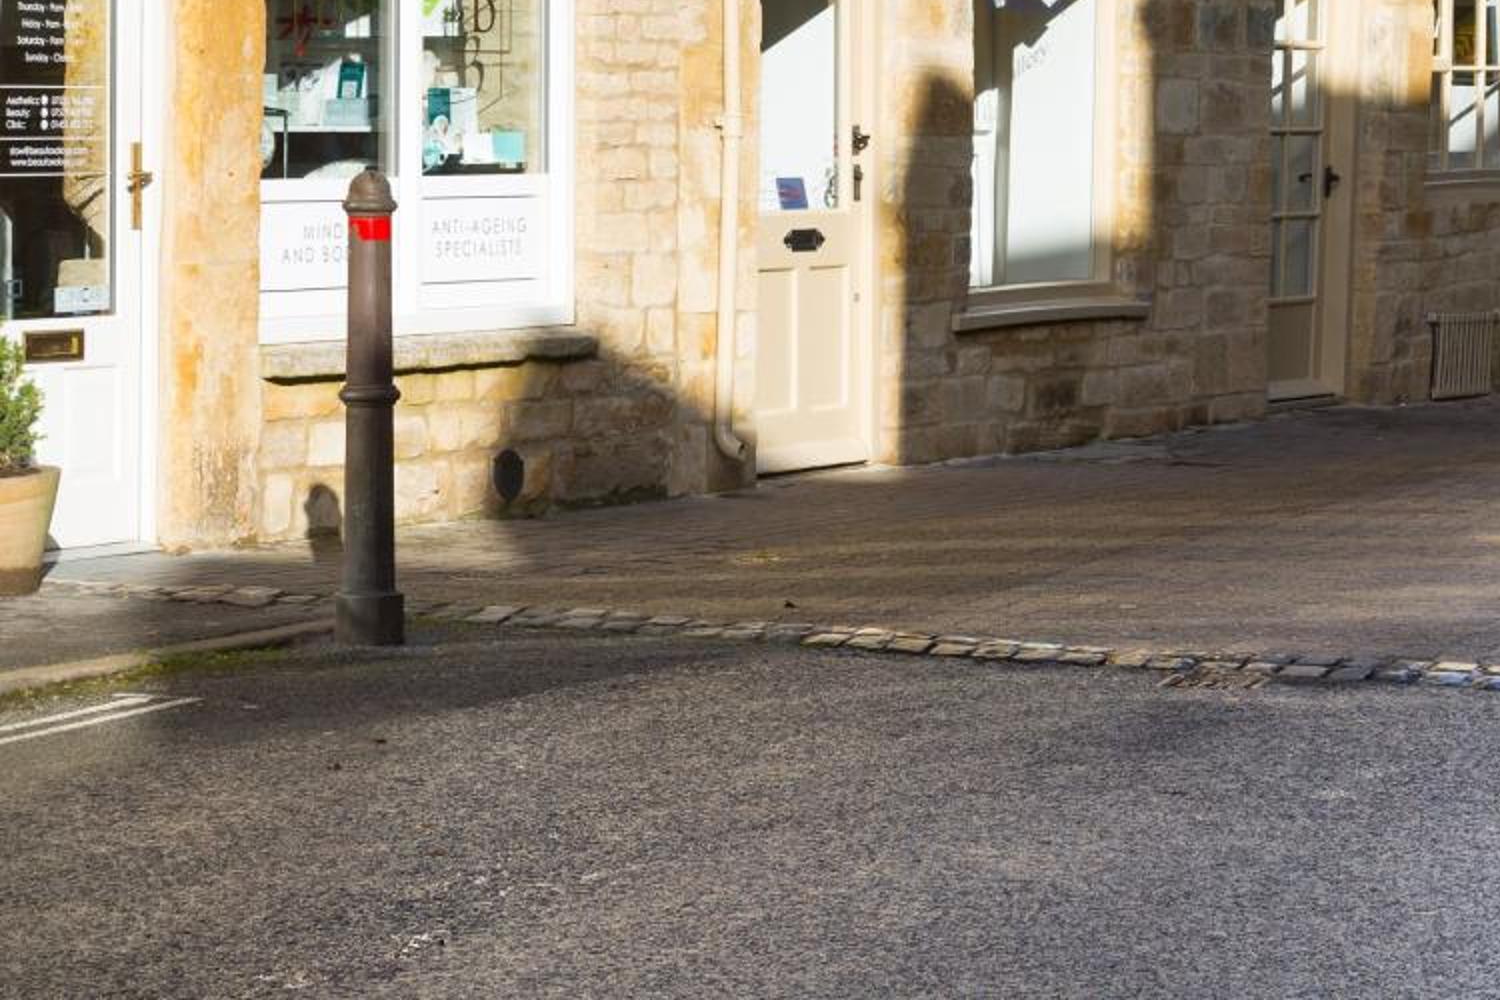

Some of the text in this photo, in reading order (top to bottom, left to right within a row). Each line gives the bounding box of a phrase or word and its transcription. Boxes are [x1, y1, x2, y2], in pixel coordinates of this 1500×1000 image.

[431, 217, 528, 236] ANTI-AGEING
[282, 249, 315, 265] AND
[435, 239, 523, 259] SPECIALISTS
